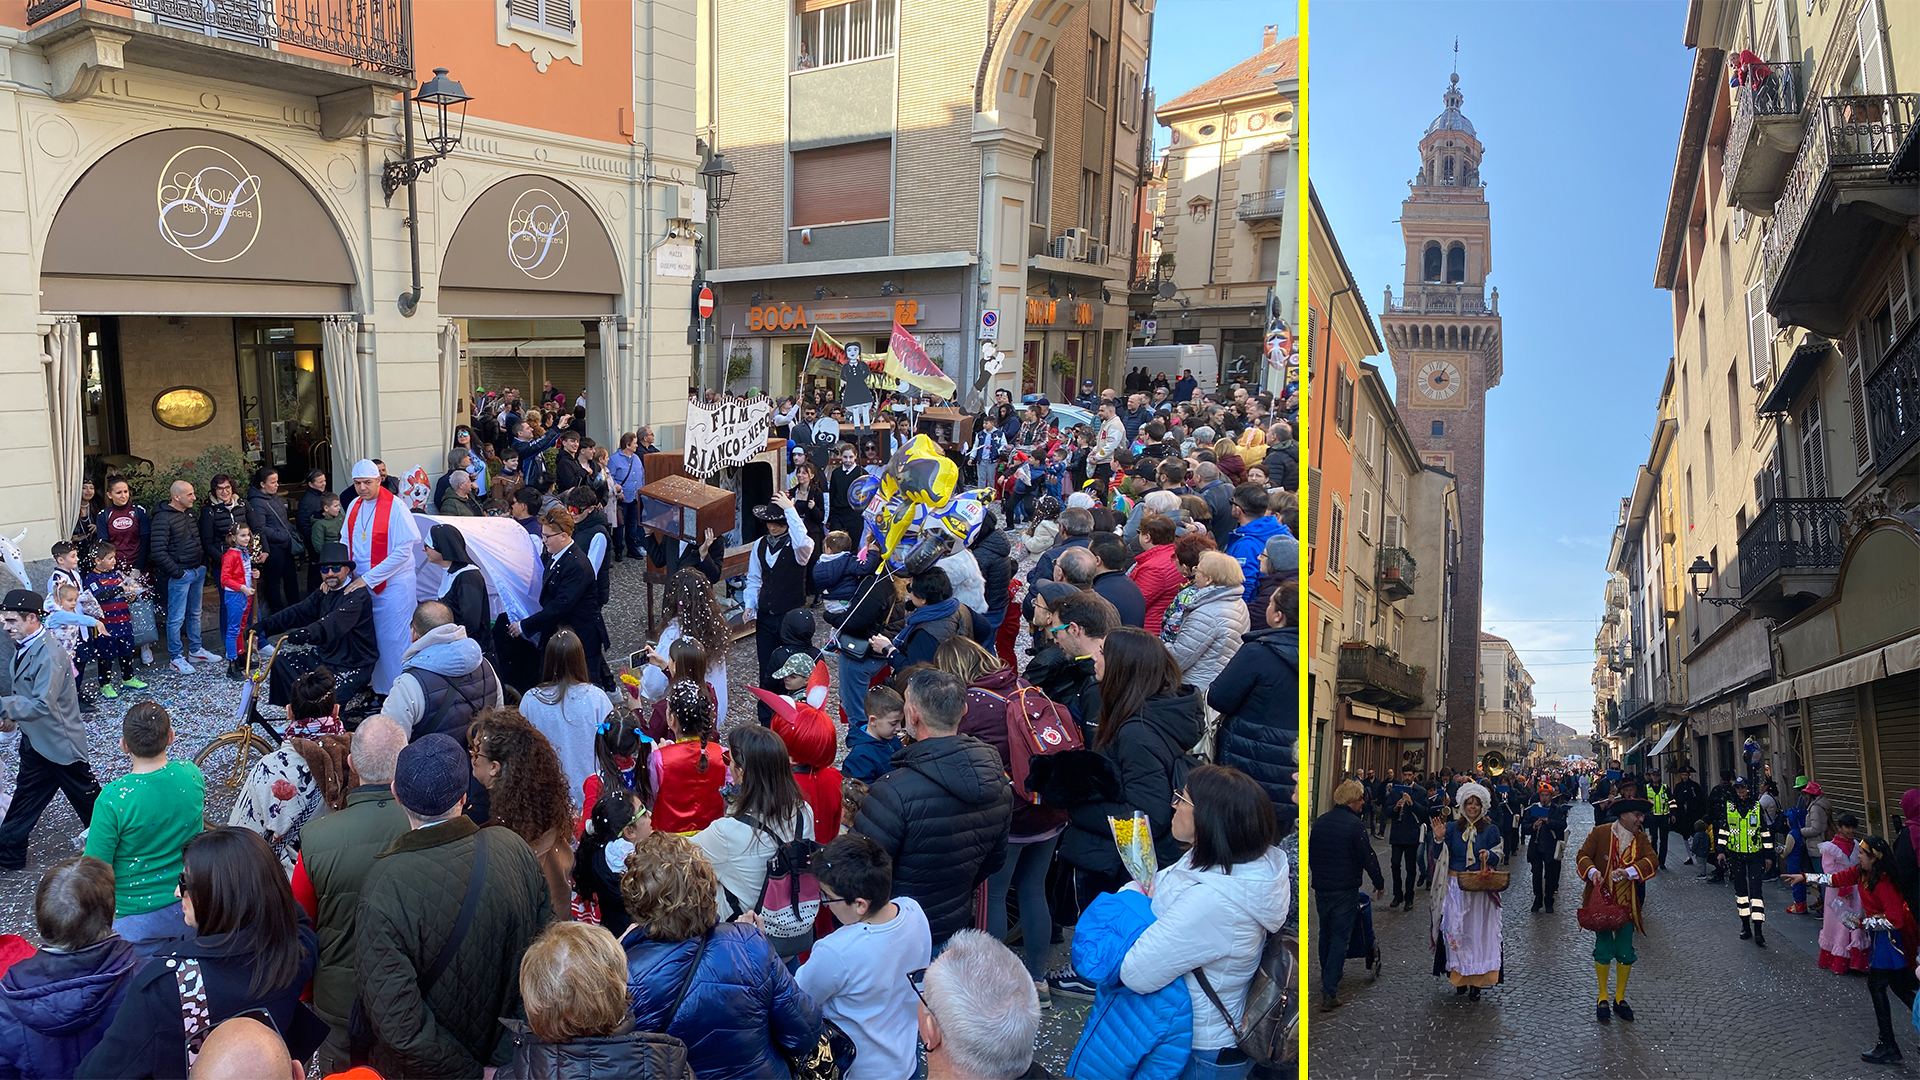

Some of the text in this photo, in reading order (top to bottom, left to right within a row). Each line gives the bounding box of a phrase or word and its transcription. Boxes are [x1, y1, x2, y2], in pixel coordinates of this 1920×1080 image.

[183, 203, 198, 213] Bar
[209, 204, 253, 219] Pastceria
[750, 305, 808, 331] BOCA
[814, 310, 888, 321] OTTICA SPECIALISTICA
[1028, 299, 1049, 324] BOCA
[711, 404, 749, 433] FILM
[687, 438, 741, 472] BIANCO
[748, 412, 771, 445] NERO
[723, 426, 735, 437] IN
[1880, 572, 1920, 608] ROSS
